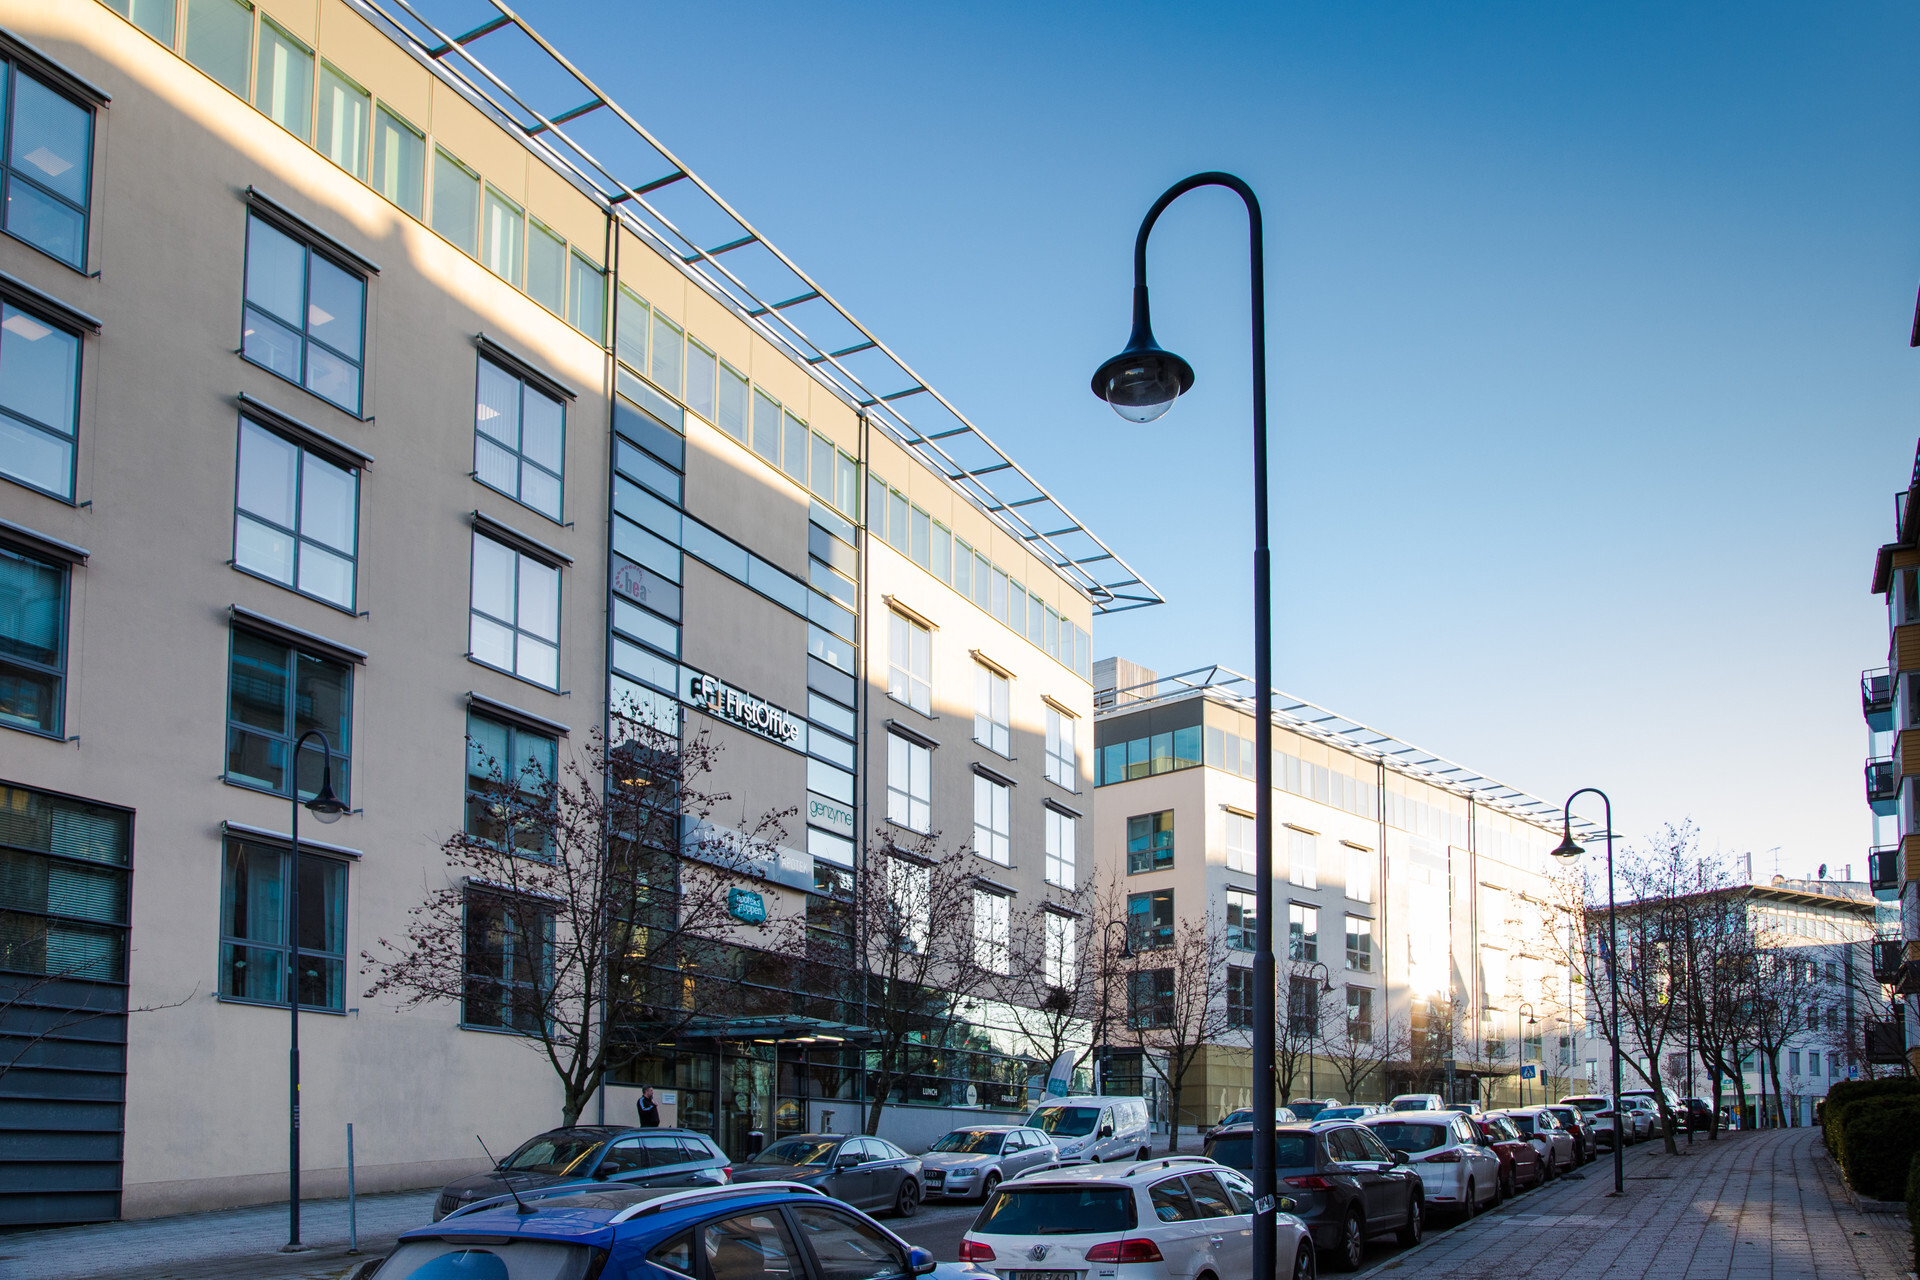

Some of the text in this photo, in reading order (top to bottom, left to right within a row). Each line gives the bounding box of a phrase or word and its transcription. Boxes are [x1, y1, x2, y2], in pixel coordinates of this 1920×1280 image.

[625, 571, 647, 602] bea
[727, 688, 799, 741] FirstOffice
[810, 800, 852, 826] genzyme
[737, 1040, 751, 1055] 42
[922, 1087, 938, 1097] LUNCH
